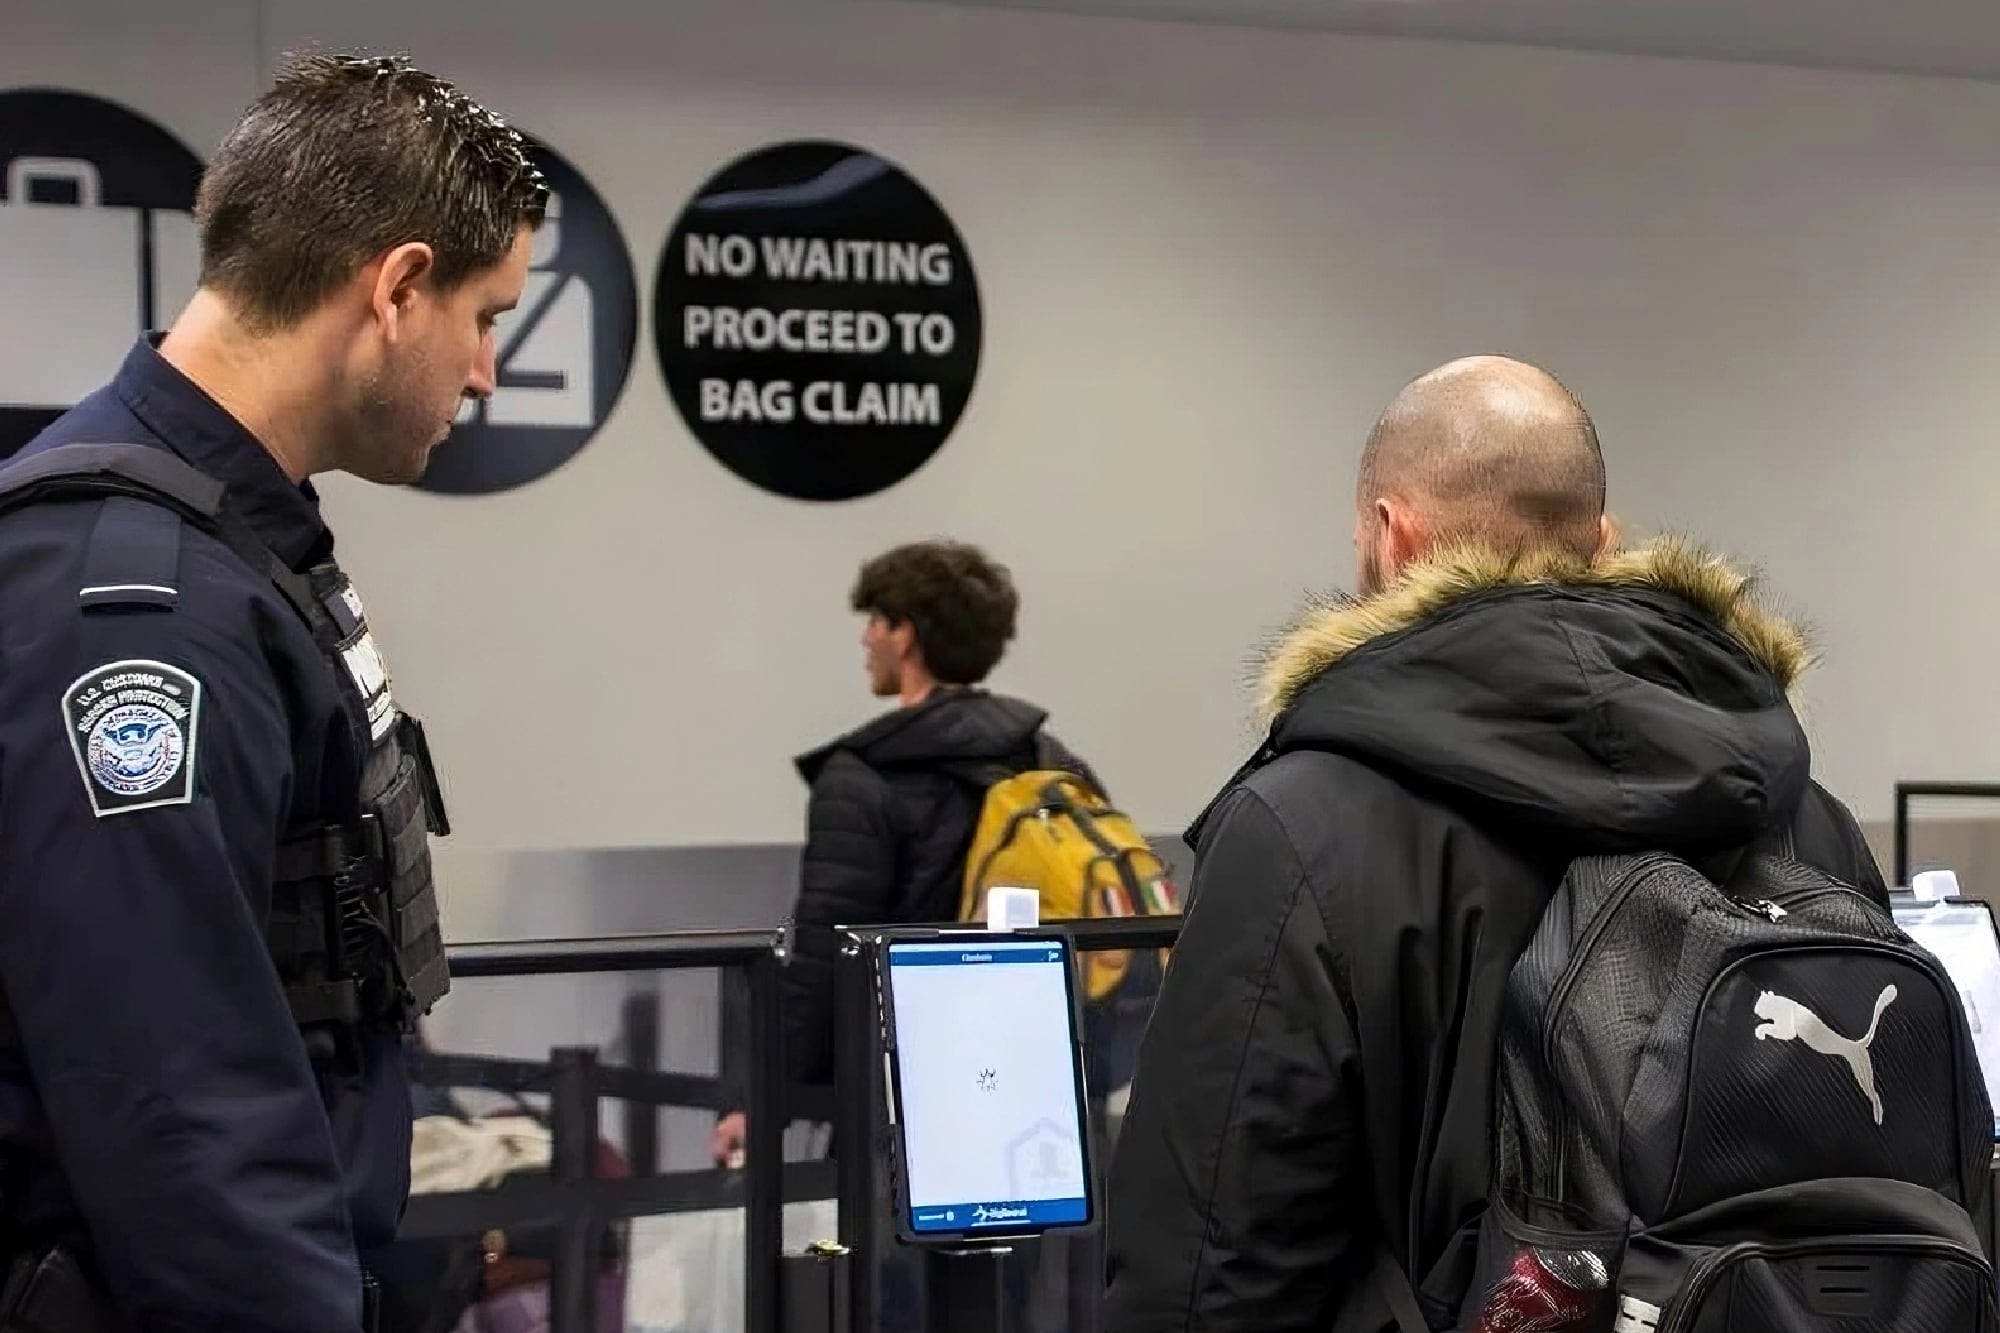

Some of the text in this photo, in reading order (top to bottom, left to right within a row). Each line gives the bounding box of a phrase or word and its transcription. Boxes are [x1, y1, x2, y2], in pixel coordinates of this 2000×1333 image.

[685, 232, 953, 285] NO WAITING
[683, 305, 955, 354] PROCEED TO
[699, 378, 941, 425] BAG CLAIM
